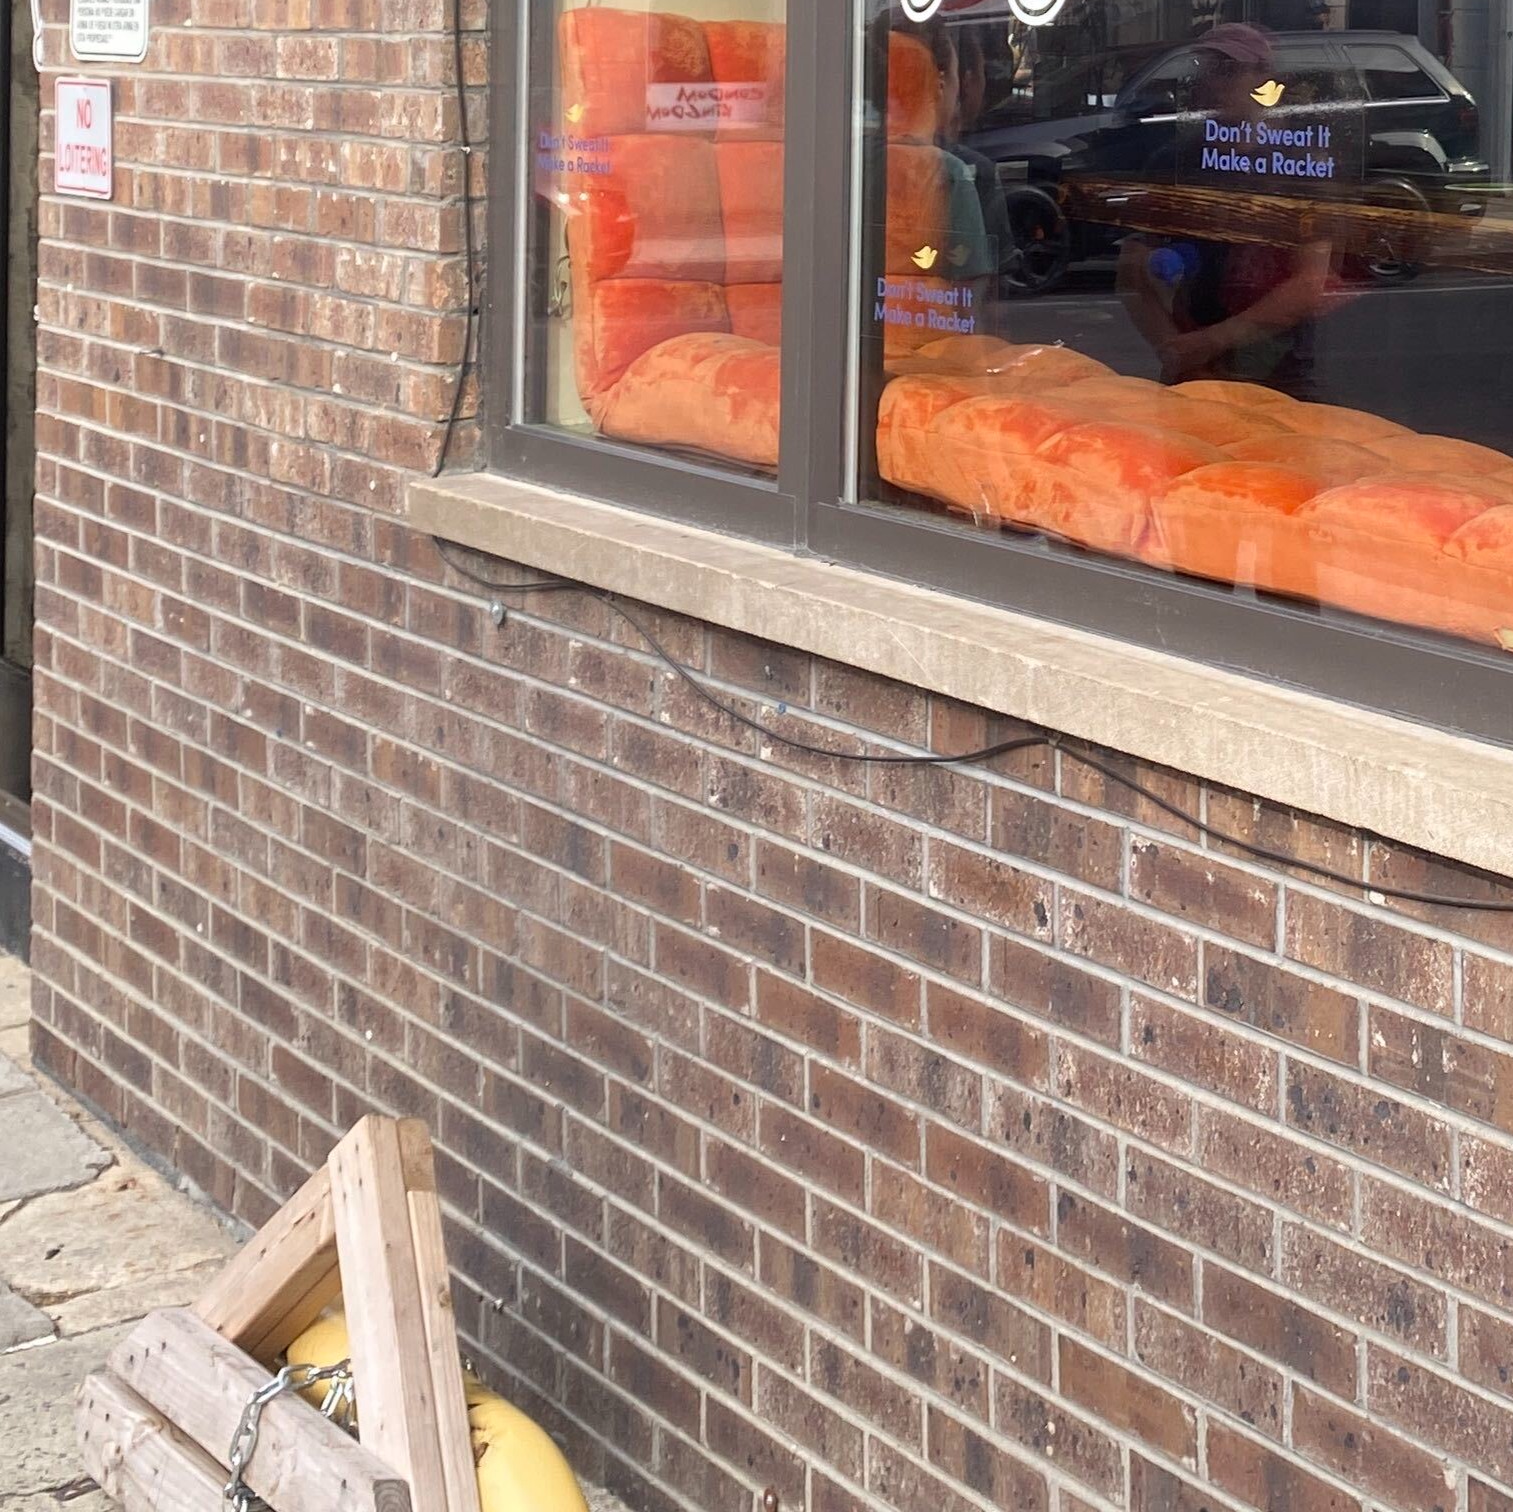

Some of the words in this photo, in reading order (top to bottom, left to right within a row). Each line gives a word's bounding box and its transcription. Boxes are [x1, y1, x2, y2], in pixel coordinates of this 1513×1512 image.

[76, 98, 92, 129] NO
[1205, 119, 1252, 143] Don't
[1256, 121, 1313, 147] Sweat
[1318, 125, 1331, 148] It
[60, 143, 106, 177] LOITERING
[1201, 148, 1251, 173] Make
[1255, 157, 1267, 174] a
[1272, 151, 1335, 178] Racket
[877, 277, 912, 300] Don't
[916, 281, 959, 306] Sweat
[962, 287, 973, 307] It
[874, 302, 911, 325] Make
[915, 312, 924, 327] a
[928, 308, 975, 334] Racket
